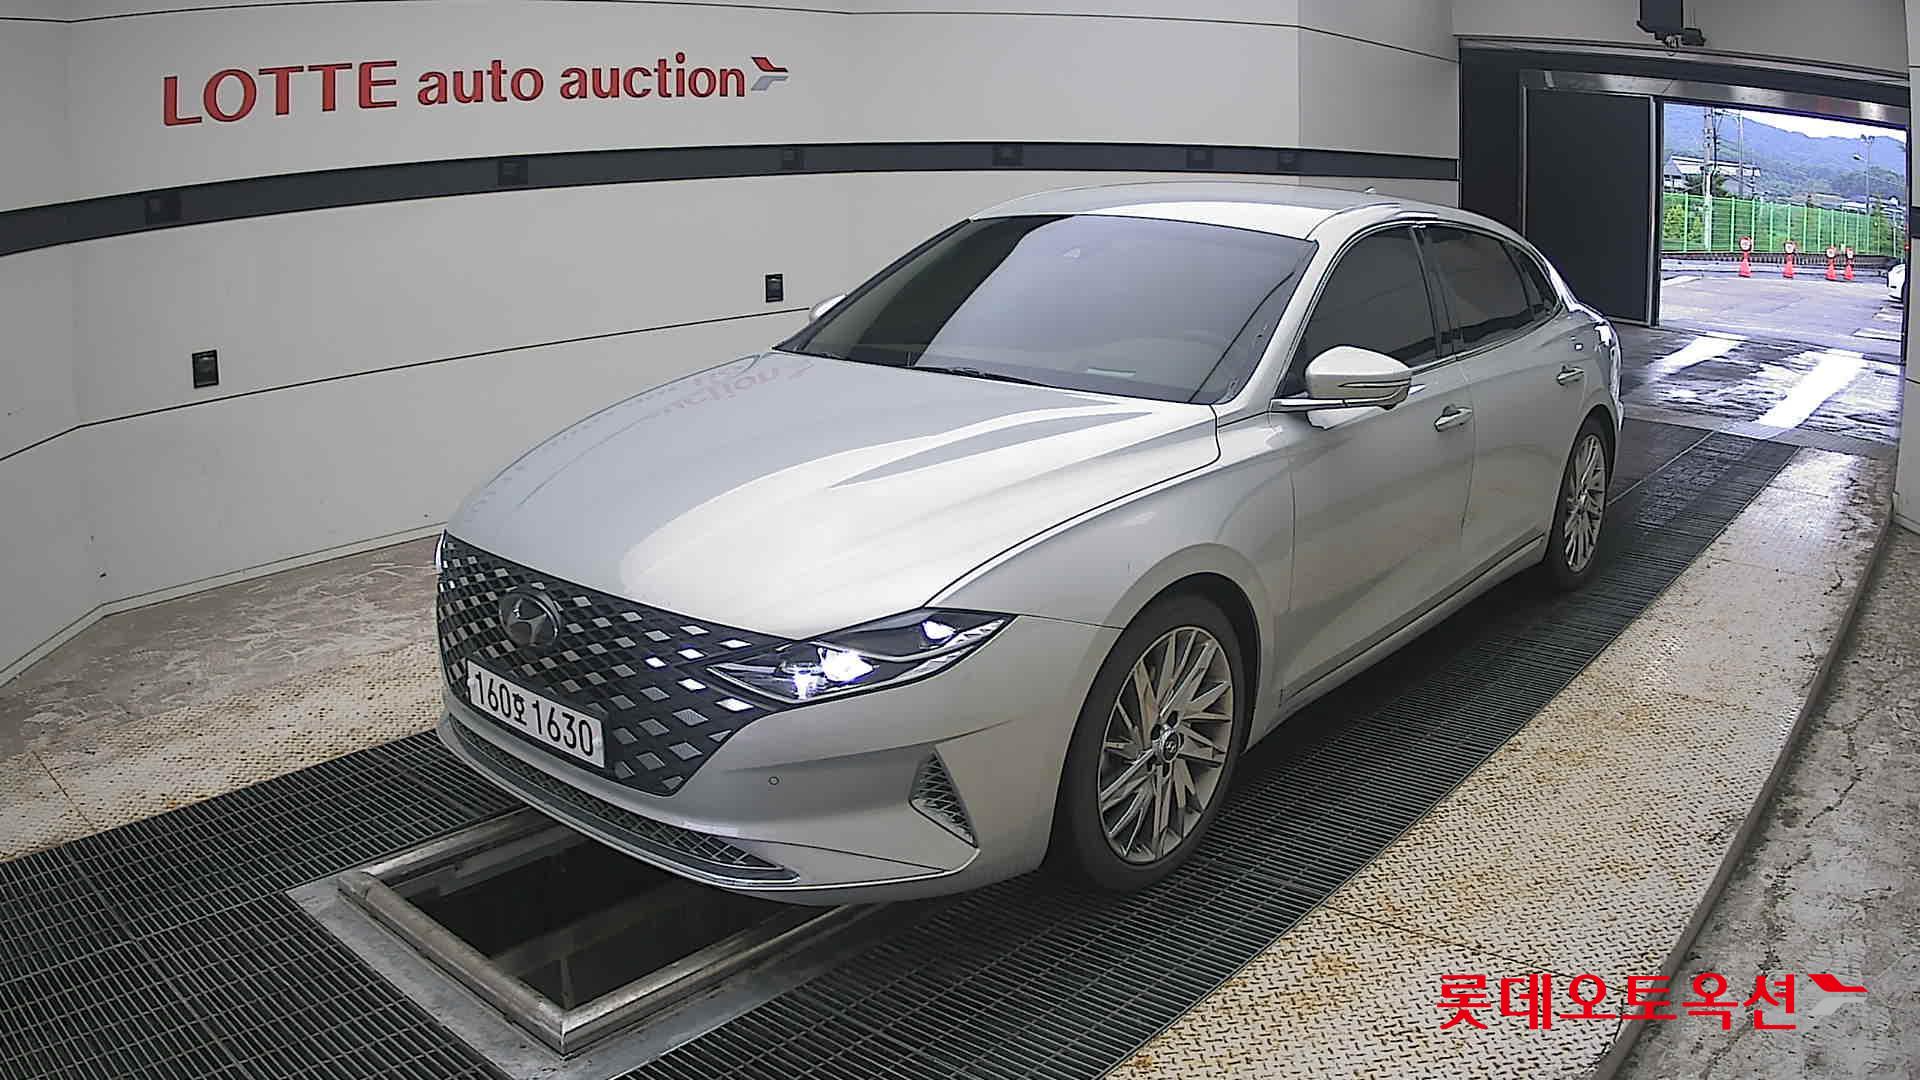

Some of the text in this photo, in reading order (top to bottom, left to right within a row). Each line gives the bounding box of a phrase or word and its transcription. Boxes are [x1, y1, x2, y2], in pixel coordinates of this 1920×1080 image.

[164, 51, 747, 126] LOTTE auto auction
[475, 671, 594, 757] 160호 1630
